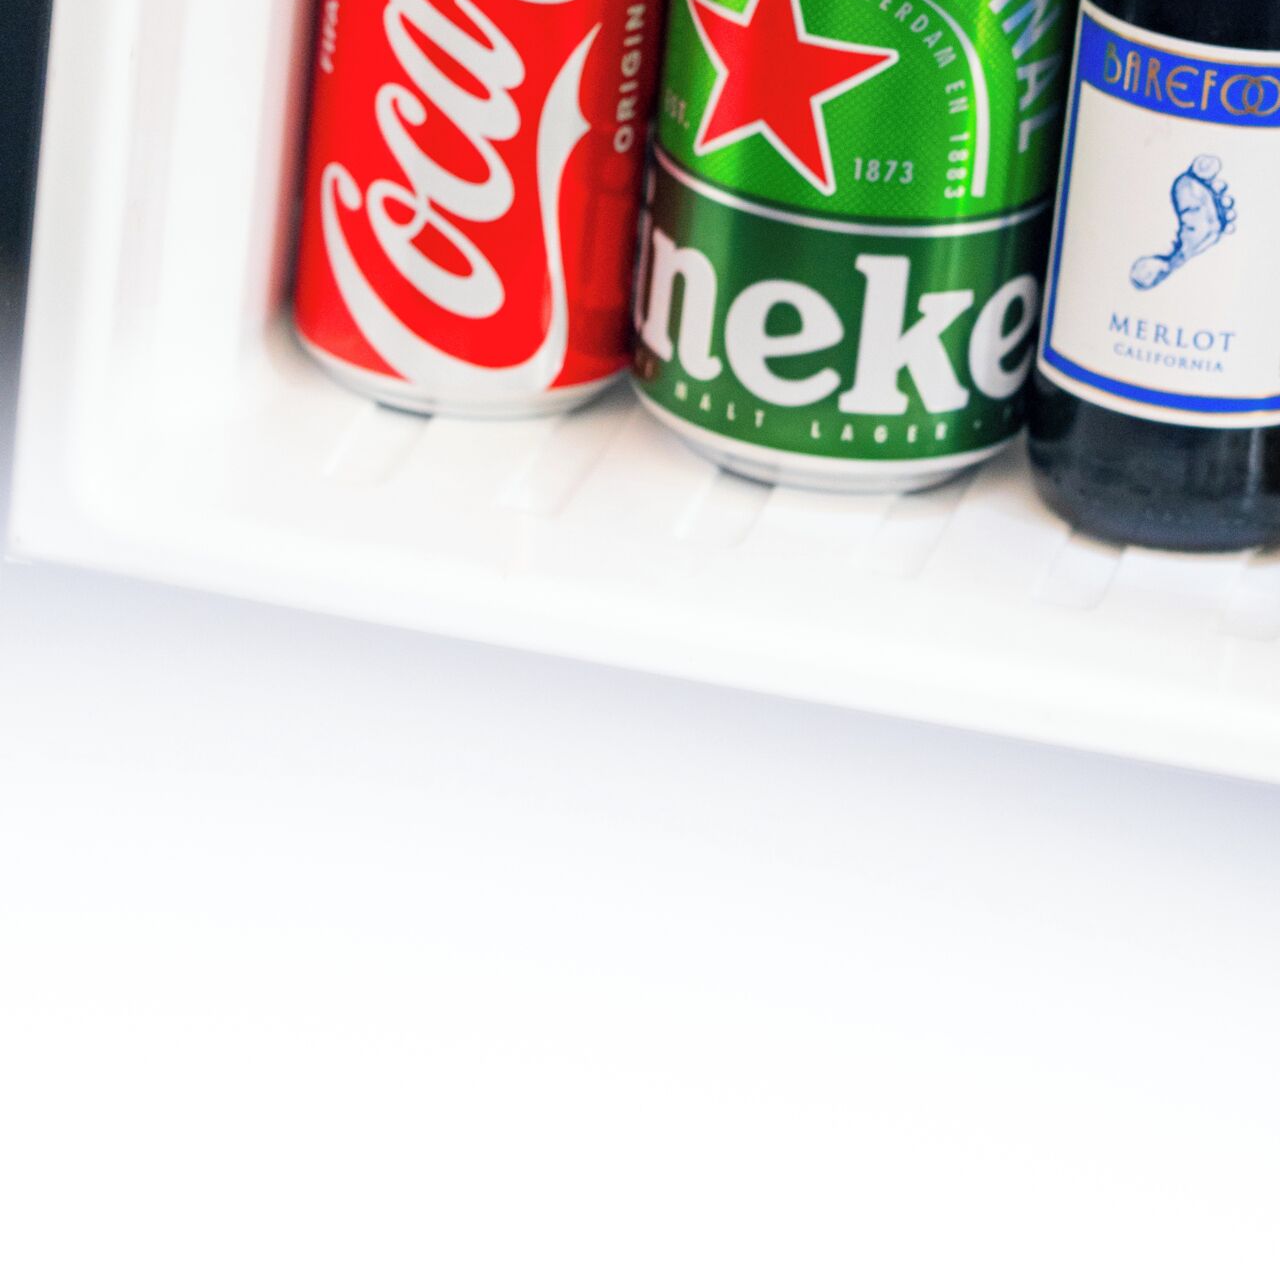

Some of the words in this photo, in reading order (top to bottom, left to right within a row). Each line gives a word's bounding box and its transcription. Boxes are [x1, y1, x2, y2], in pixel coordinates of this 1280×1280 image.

[945, 78, 969, 115] EN
[853, 157, 914, 185] 1873
[1109, 312, 1237, 353] MERLOT
[1113, 342, 1224, 373] CALIFORNIA
[812, 419, 948, 444] LAGER
